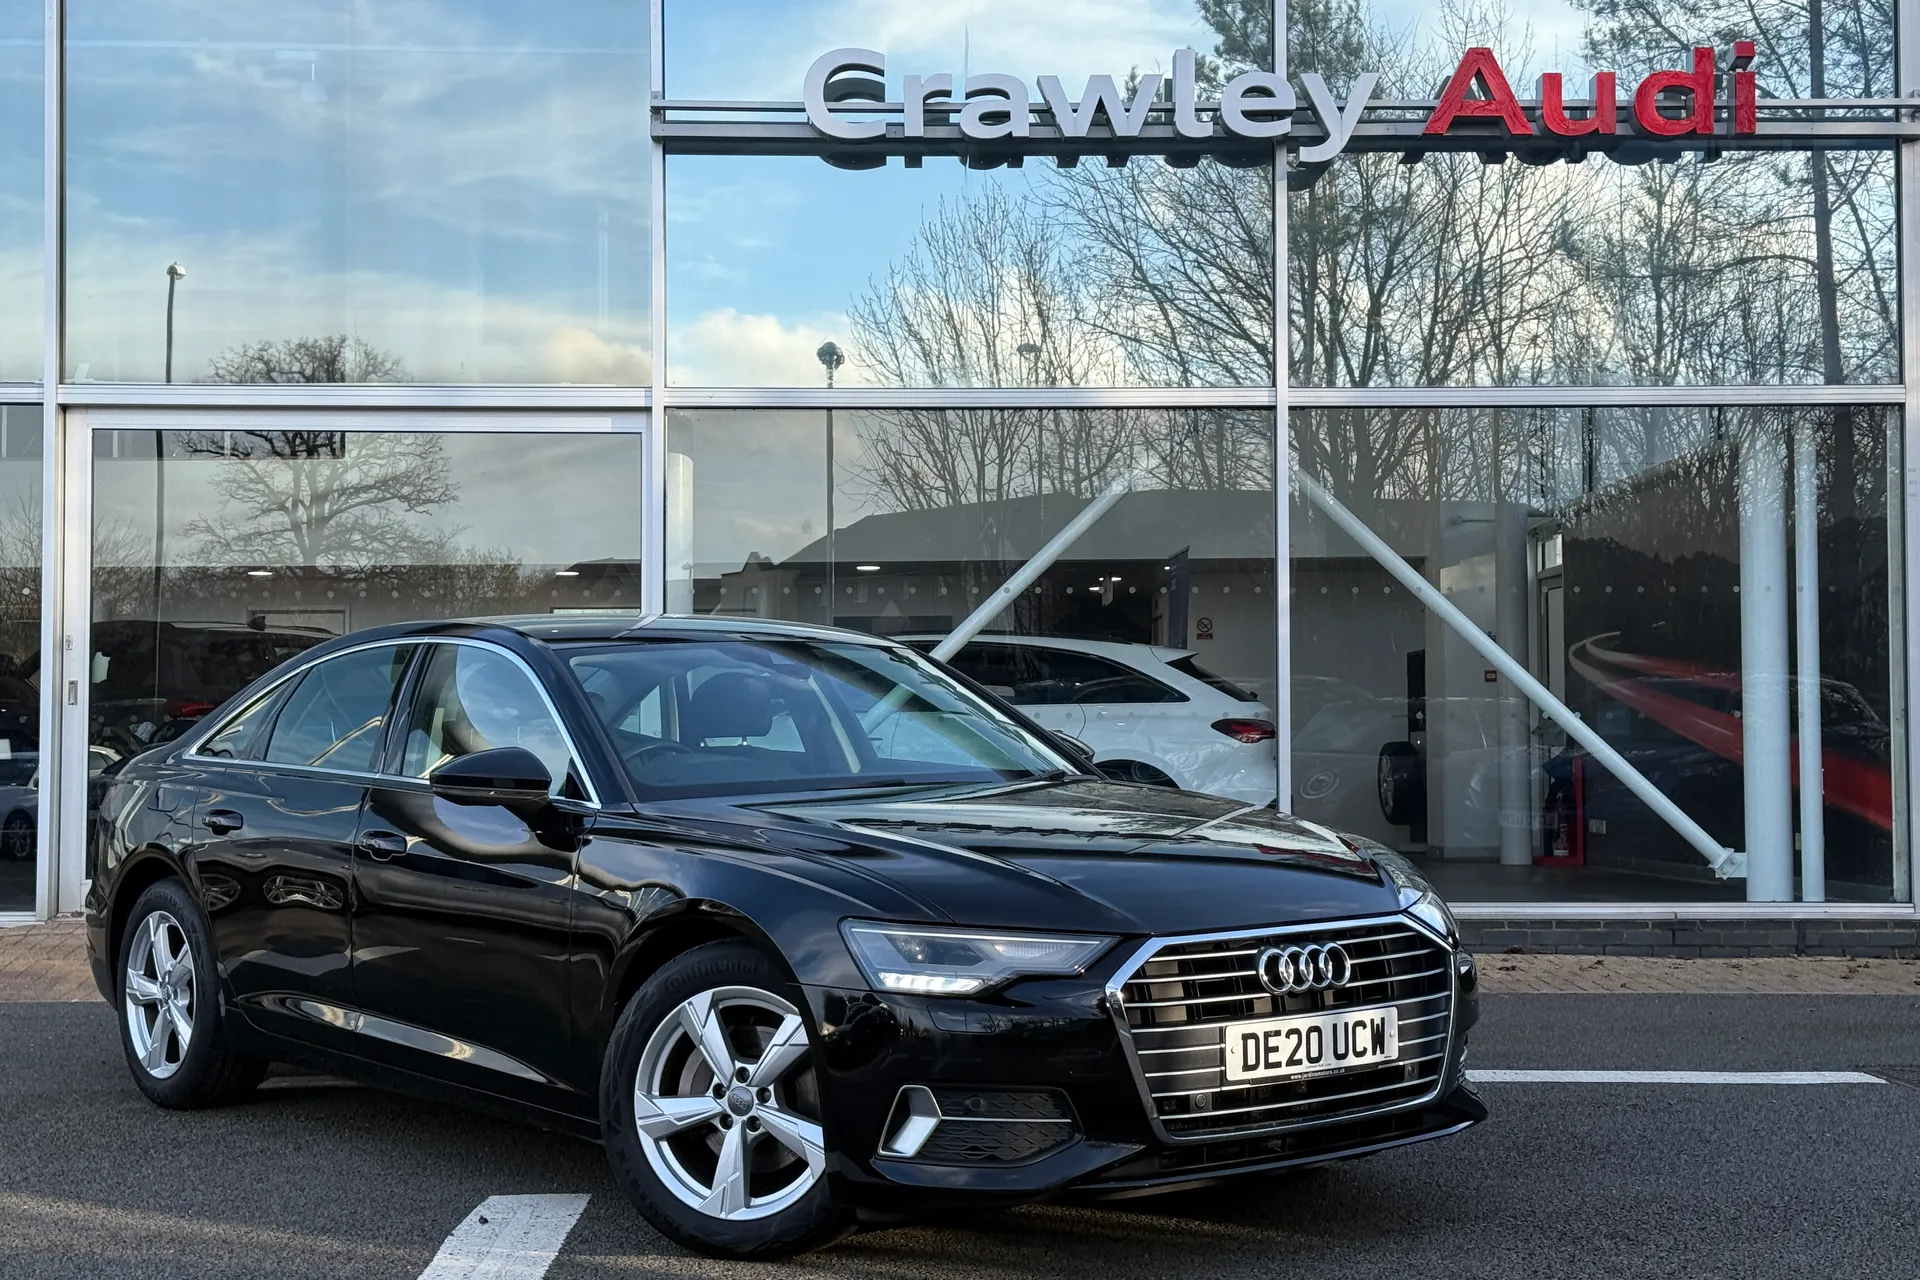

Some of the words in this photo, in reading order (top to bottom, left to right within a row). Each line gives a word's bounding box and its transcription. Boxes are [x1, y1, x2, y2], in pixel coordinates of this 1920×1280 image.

[803, 47, 1380, 163] Crawley
[1423, 41, 1757, 136] Audi
[664, 959, 759, 993] Continental
[1241, 1025, 1323, 1073] DE20
[1332, 1016, 1386, 1061] UCW
